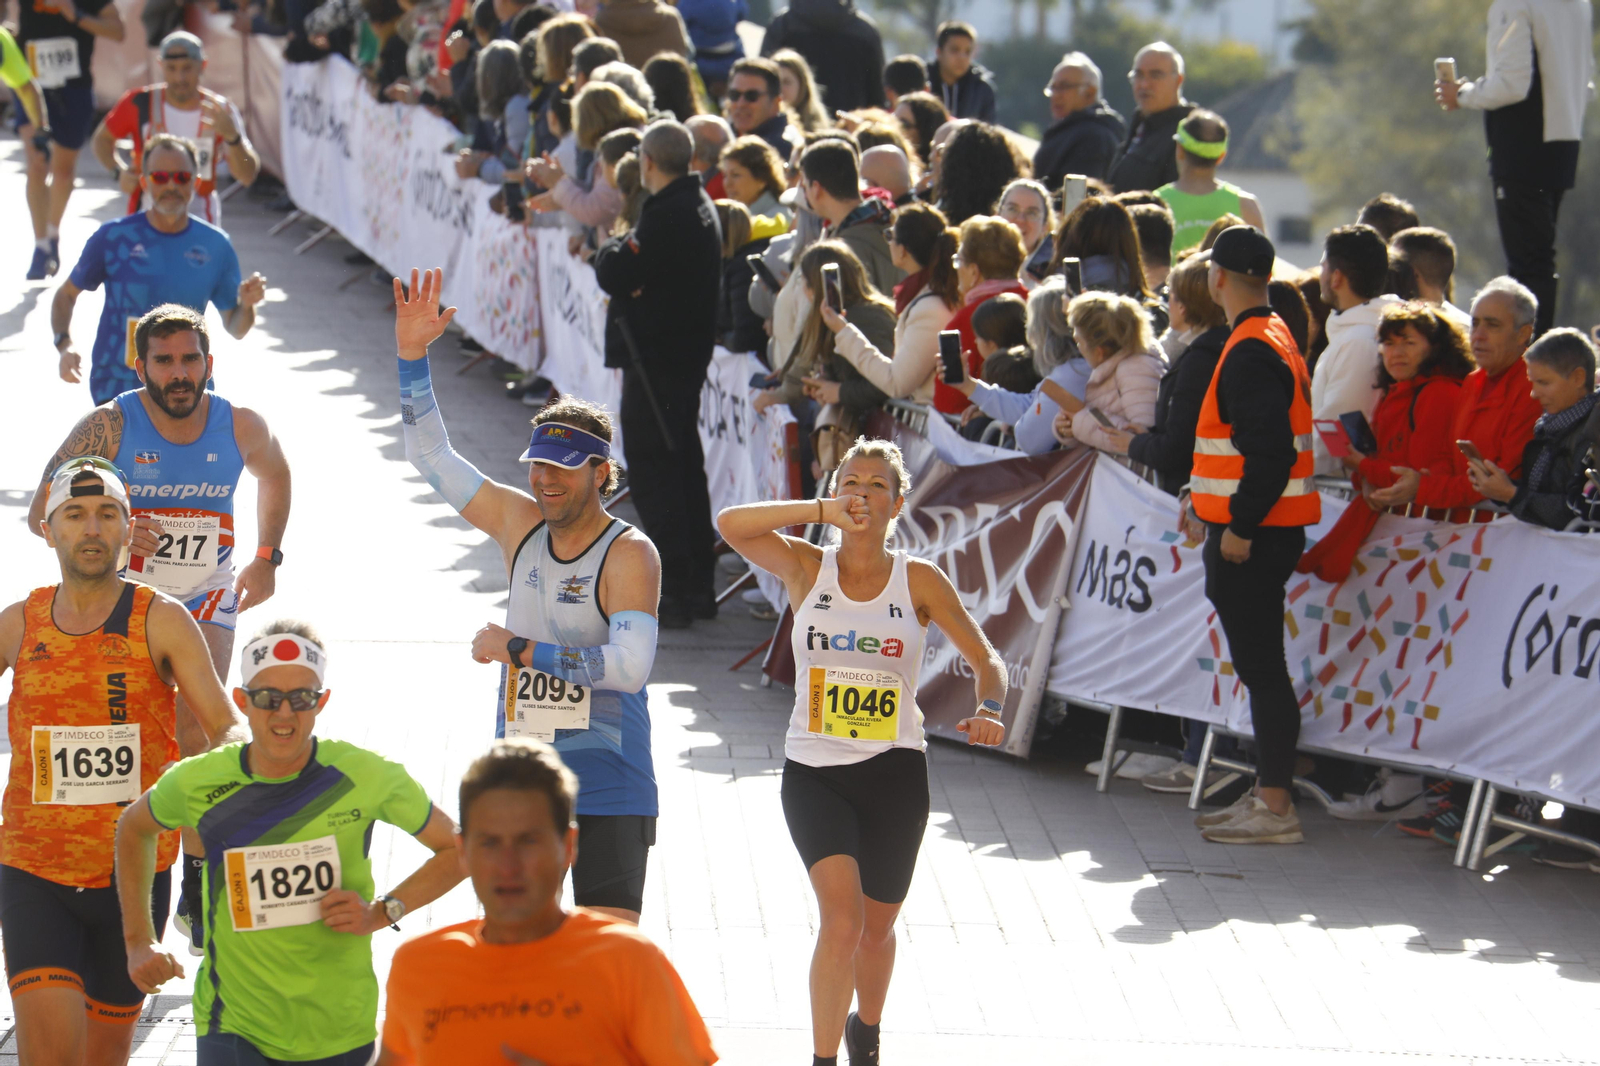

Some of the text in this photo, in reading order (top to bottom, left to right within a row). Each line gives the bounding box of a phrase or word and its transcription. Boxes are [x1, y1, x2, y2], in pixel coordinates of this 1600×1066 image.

[129, 482, 231, 499] enerplus
[161, 519, 195, 529] IMDECO
[155, 533, 207, 560] 217
[1076, 525, 1157, 613] Más
[889, 603, 903, 618] in
[807, 625, 904, 658] indea
[837, 671, 874, 681] IMDECO
[517, 671, 585, 704] 2093
[812, 691, 820, 718] CAJÓN
[827, 685, 896, 718] 1046
[836, 714, 865, 722] INMACULADA
[64, 731, 105, 740] IMDECO
[40, 756, 48, 786] CAJÓN
[54, 745, 134, 779] 1639
[106, 778, 129, 786] SERRANO
[351, 808, 361, 822] 9
[257, 848, 300, 860] IMDECO
[250, 861, 334, 900] 1820
